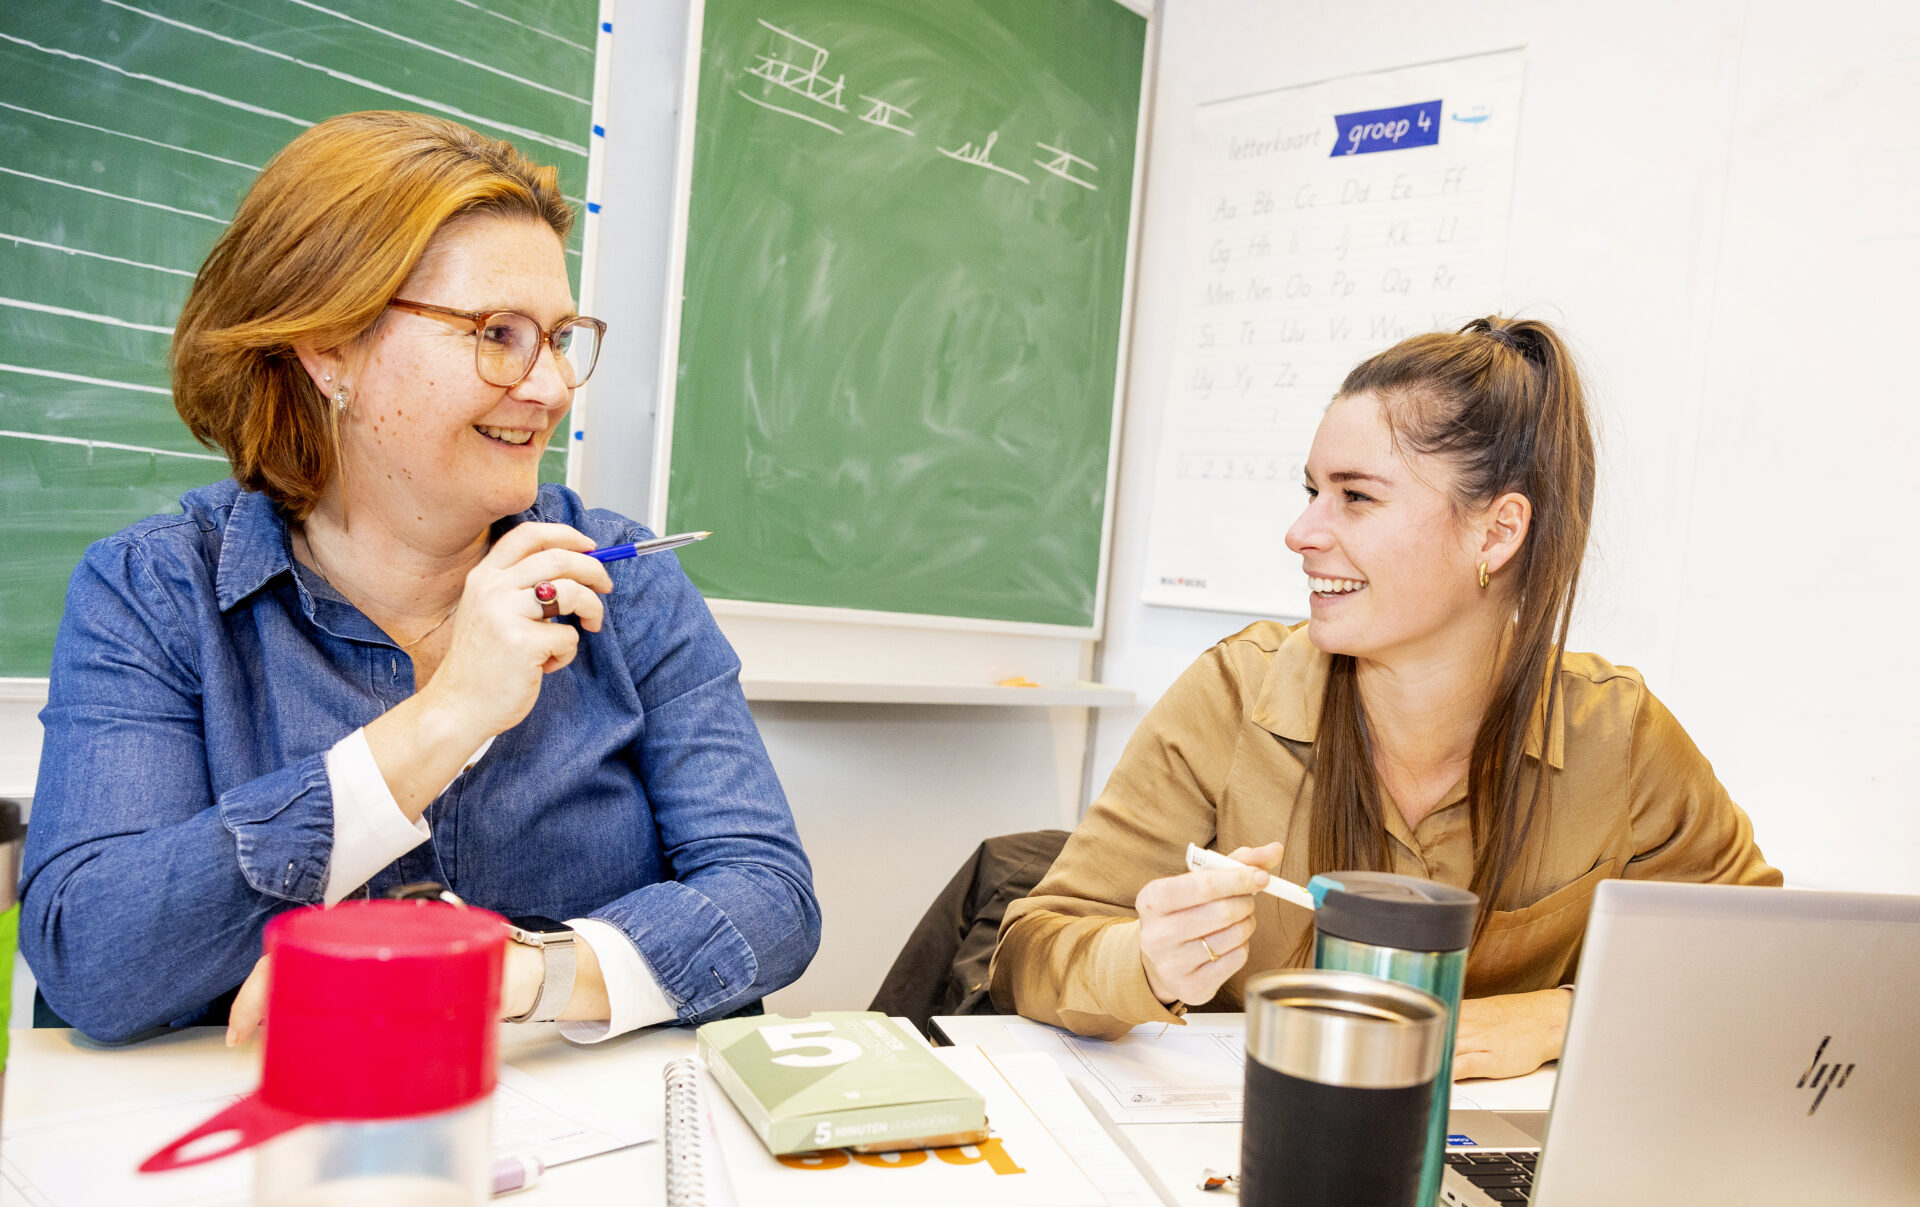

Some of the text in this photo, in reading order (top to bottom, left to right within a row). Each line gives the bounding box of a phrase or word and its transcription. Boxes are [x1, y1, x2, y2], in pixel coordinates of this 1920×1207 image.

[1345, 118, 1410, 155] groep
[1417, 109, 1431, 133] 4
[1212, 165, 1467, 222] Aa Bb Cc Dd Ee Ff
[1385, 220, 1410, 248] Kk
[1284, 272, 1312, 299] Oo
[1329, 270, 1356, 299] Pp
[1380, 267, 1412, 297] Qq
[1430, 263, 1457, 292] Rr
[1279, 318, 1305, 343] Uu
[1273, 361, 1299, 389] Zz
[758, 1021, 863, 1068] 5
[1796, 1035, 1856, 1116] hp
[814, 1120, 832, 1144] 5
[834, 1121, 888, 1138] MINUTEN
